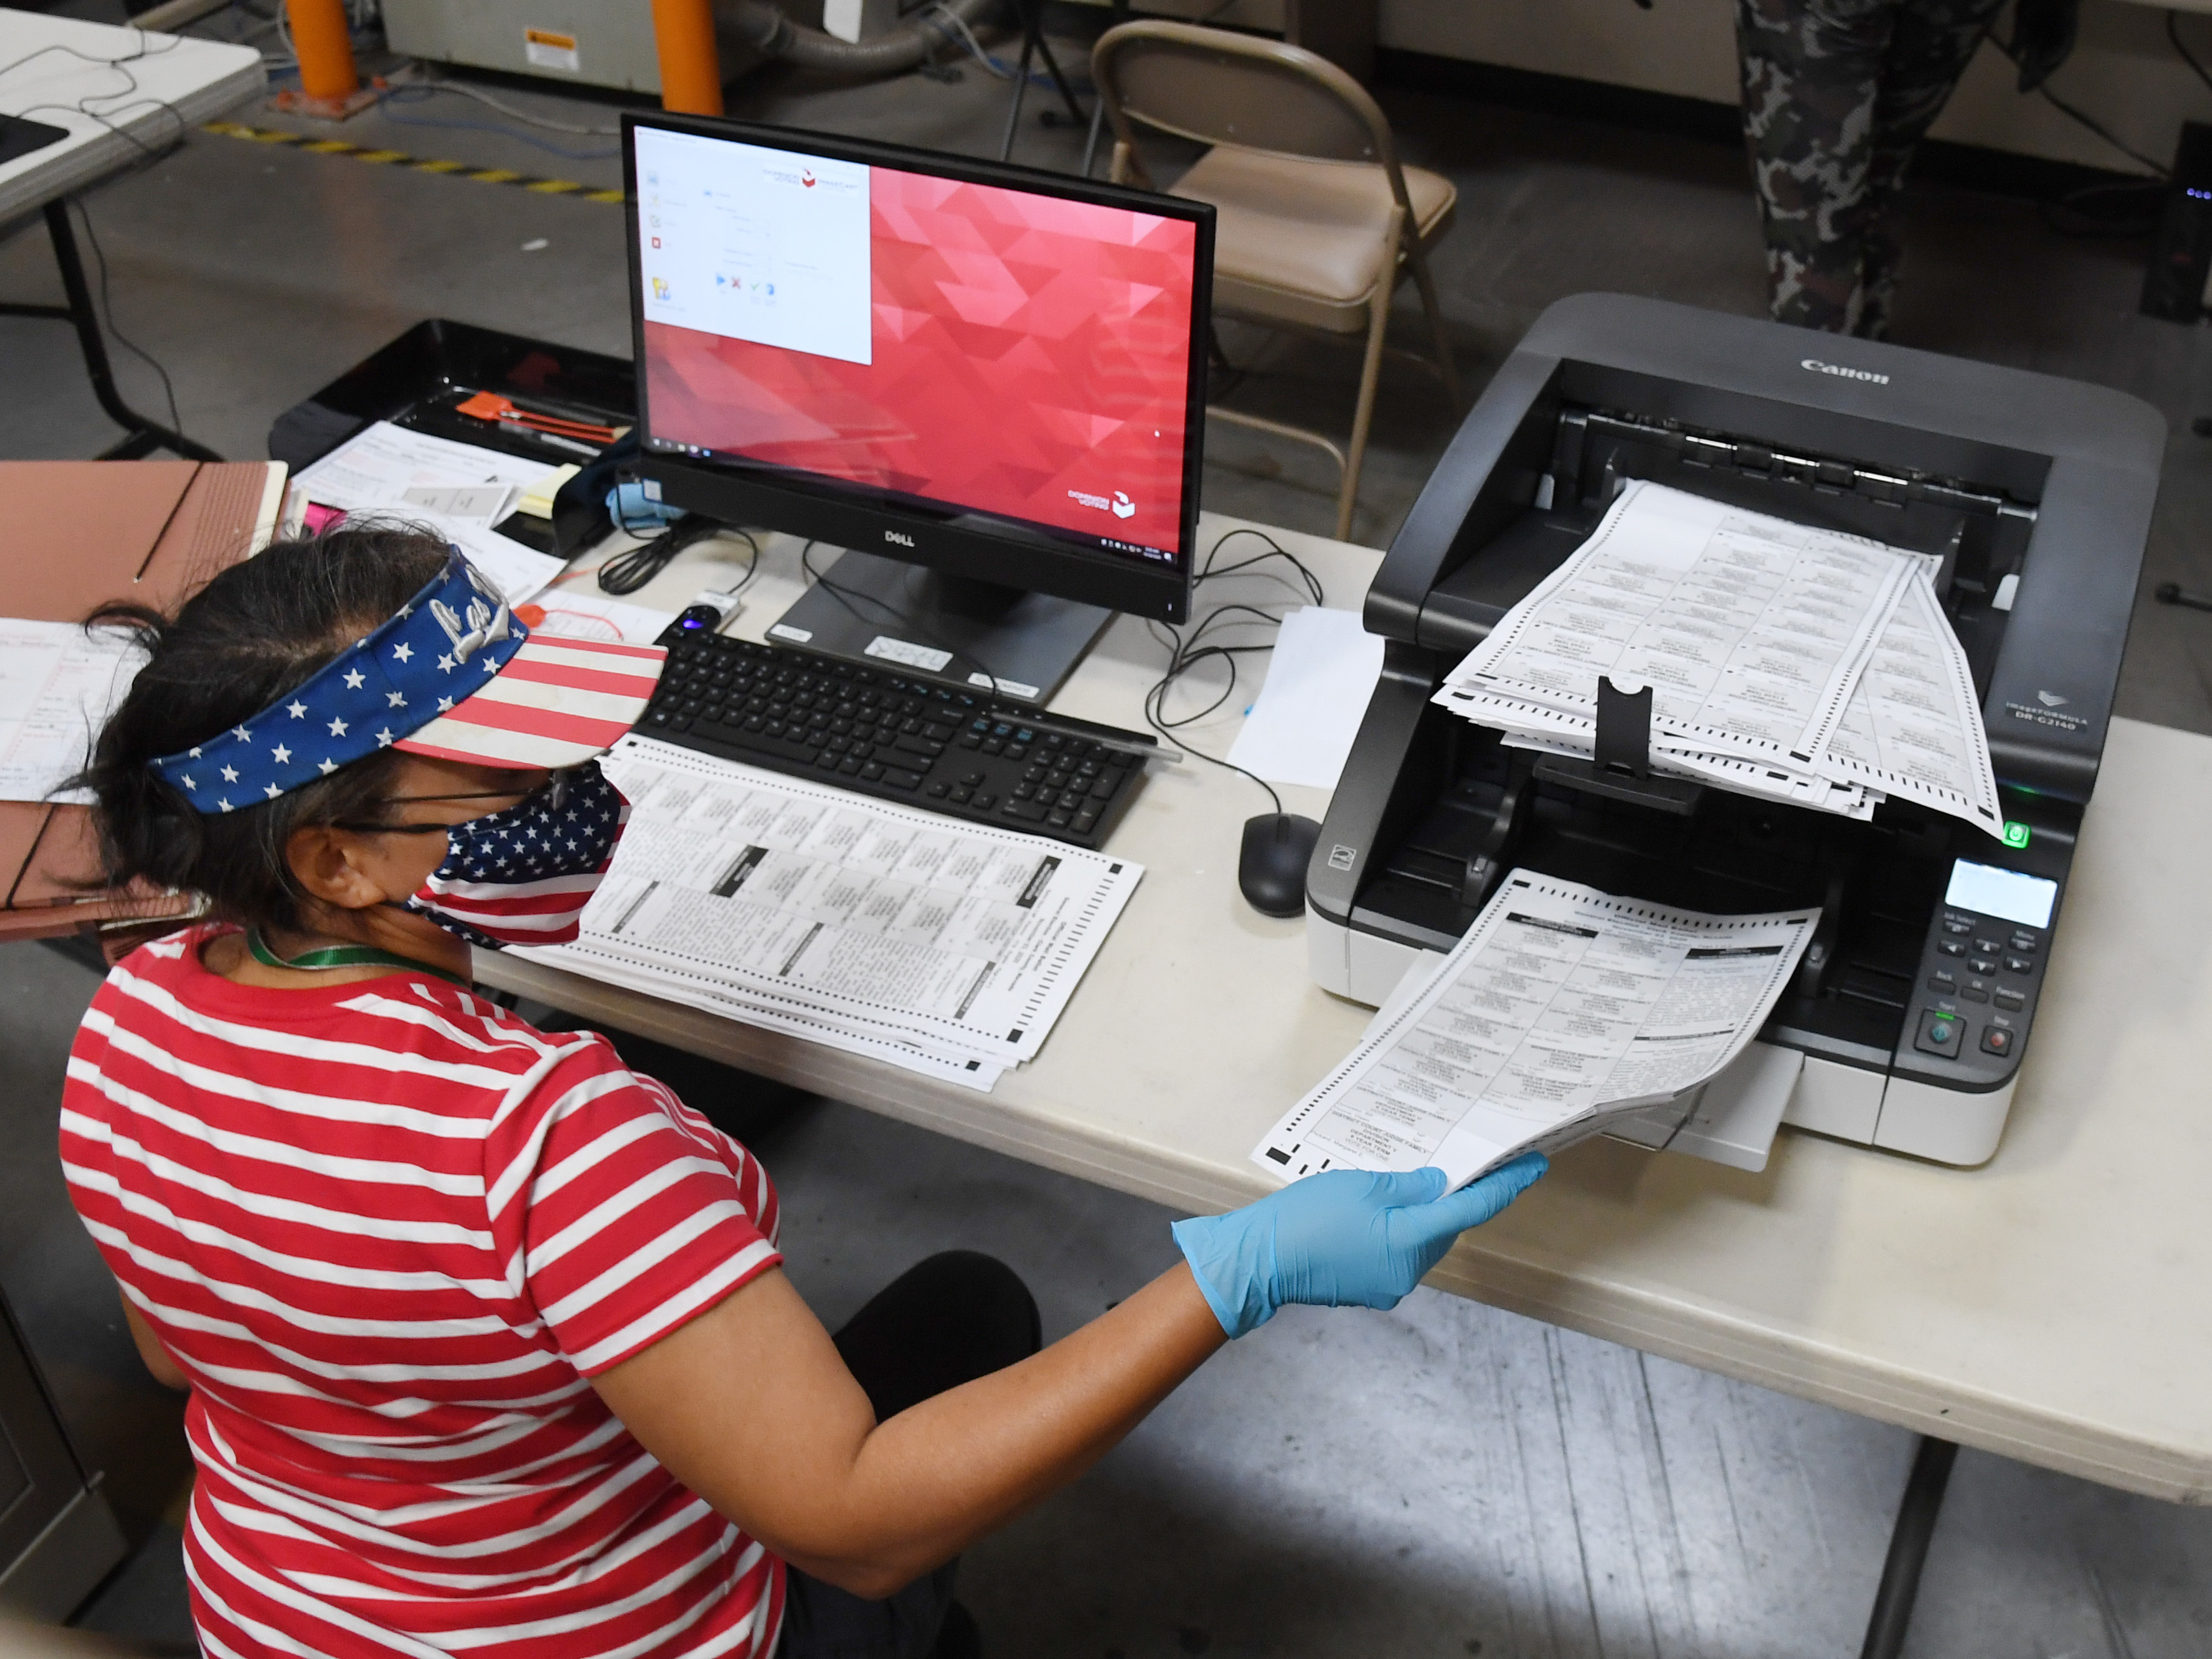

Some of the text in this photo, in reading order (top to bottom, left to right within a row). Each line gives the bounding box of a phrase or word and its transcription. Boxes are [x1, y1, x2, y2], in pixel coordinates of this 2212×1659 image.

[1801, 359, 1890, 385] Canon
[885, 530, 916, 548] DELL
[1349, 1128, 1393, 1150] DEPARTMENT
[1355, 1136, 1373, 1148] YEAR
[1373, 1144, 1391, 1156] TERM
